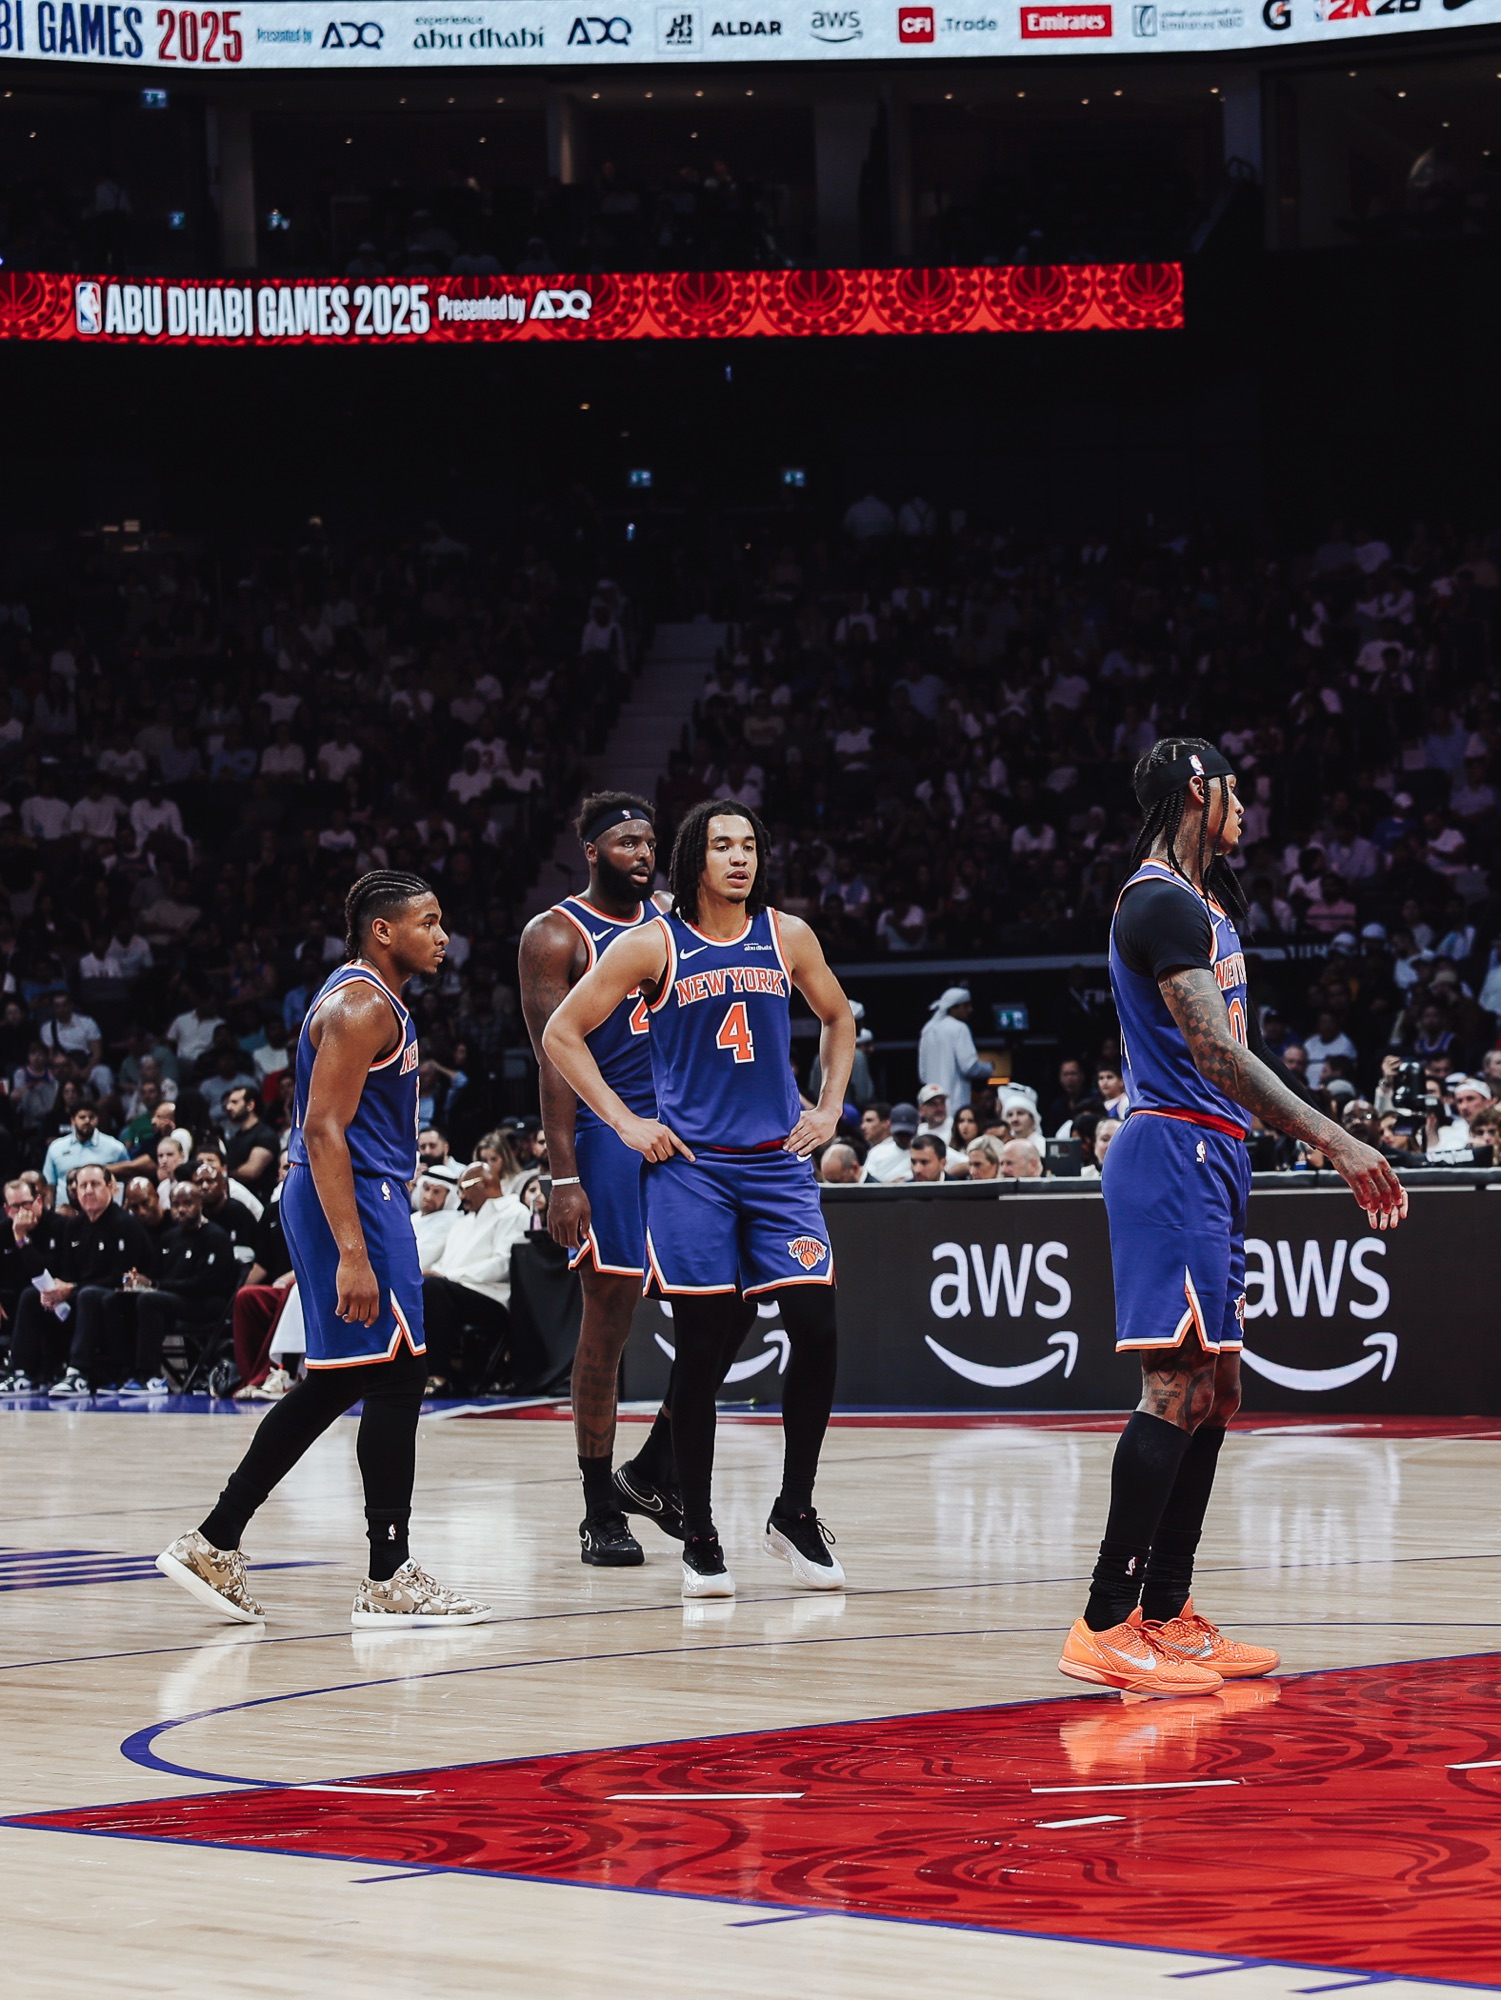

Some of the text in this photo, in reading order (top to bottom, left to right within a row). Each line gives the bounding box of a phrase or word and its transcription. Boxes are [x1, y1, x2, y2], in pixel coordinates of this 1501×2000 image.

[38, 1, 143, 58] GAMES
[157, 9, 242, 62] 2025
[567, 17, 632, 46] ADQ
[711, 21, 781, 36] ALDAR
[811, 11, 860, 28] aws
[901, 17, 931, 33] CFI
[1027, 13, 1105, 31] Emirates
[321, 22, 384, 49] ADQ
[414, 27, 544, 48] abu dhabi
[105, 284, 592, 336] ABU DHABI GAMES 2025 Presented by ADQ
[675, 967, 785, 1008] NEW YORK
[716, 1001, 755, 1064] 4
[931, 1241, 1070, 1319] aws
[1244, 1236, 1390, 1320] aws
